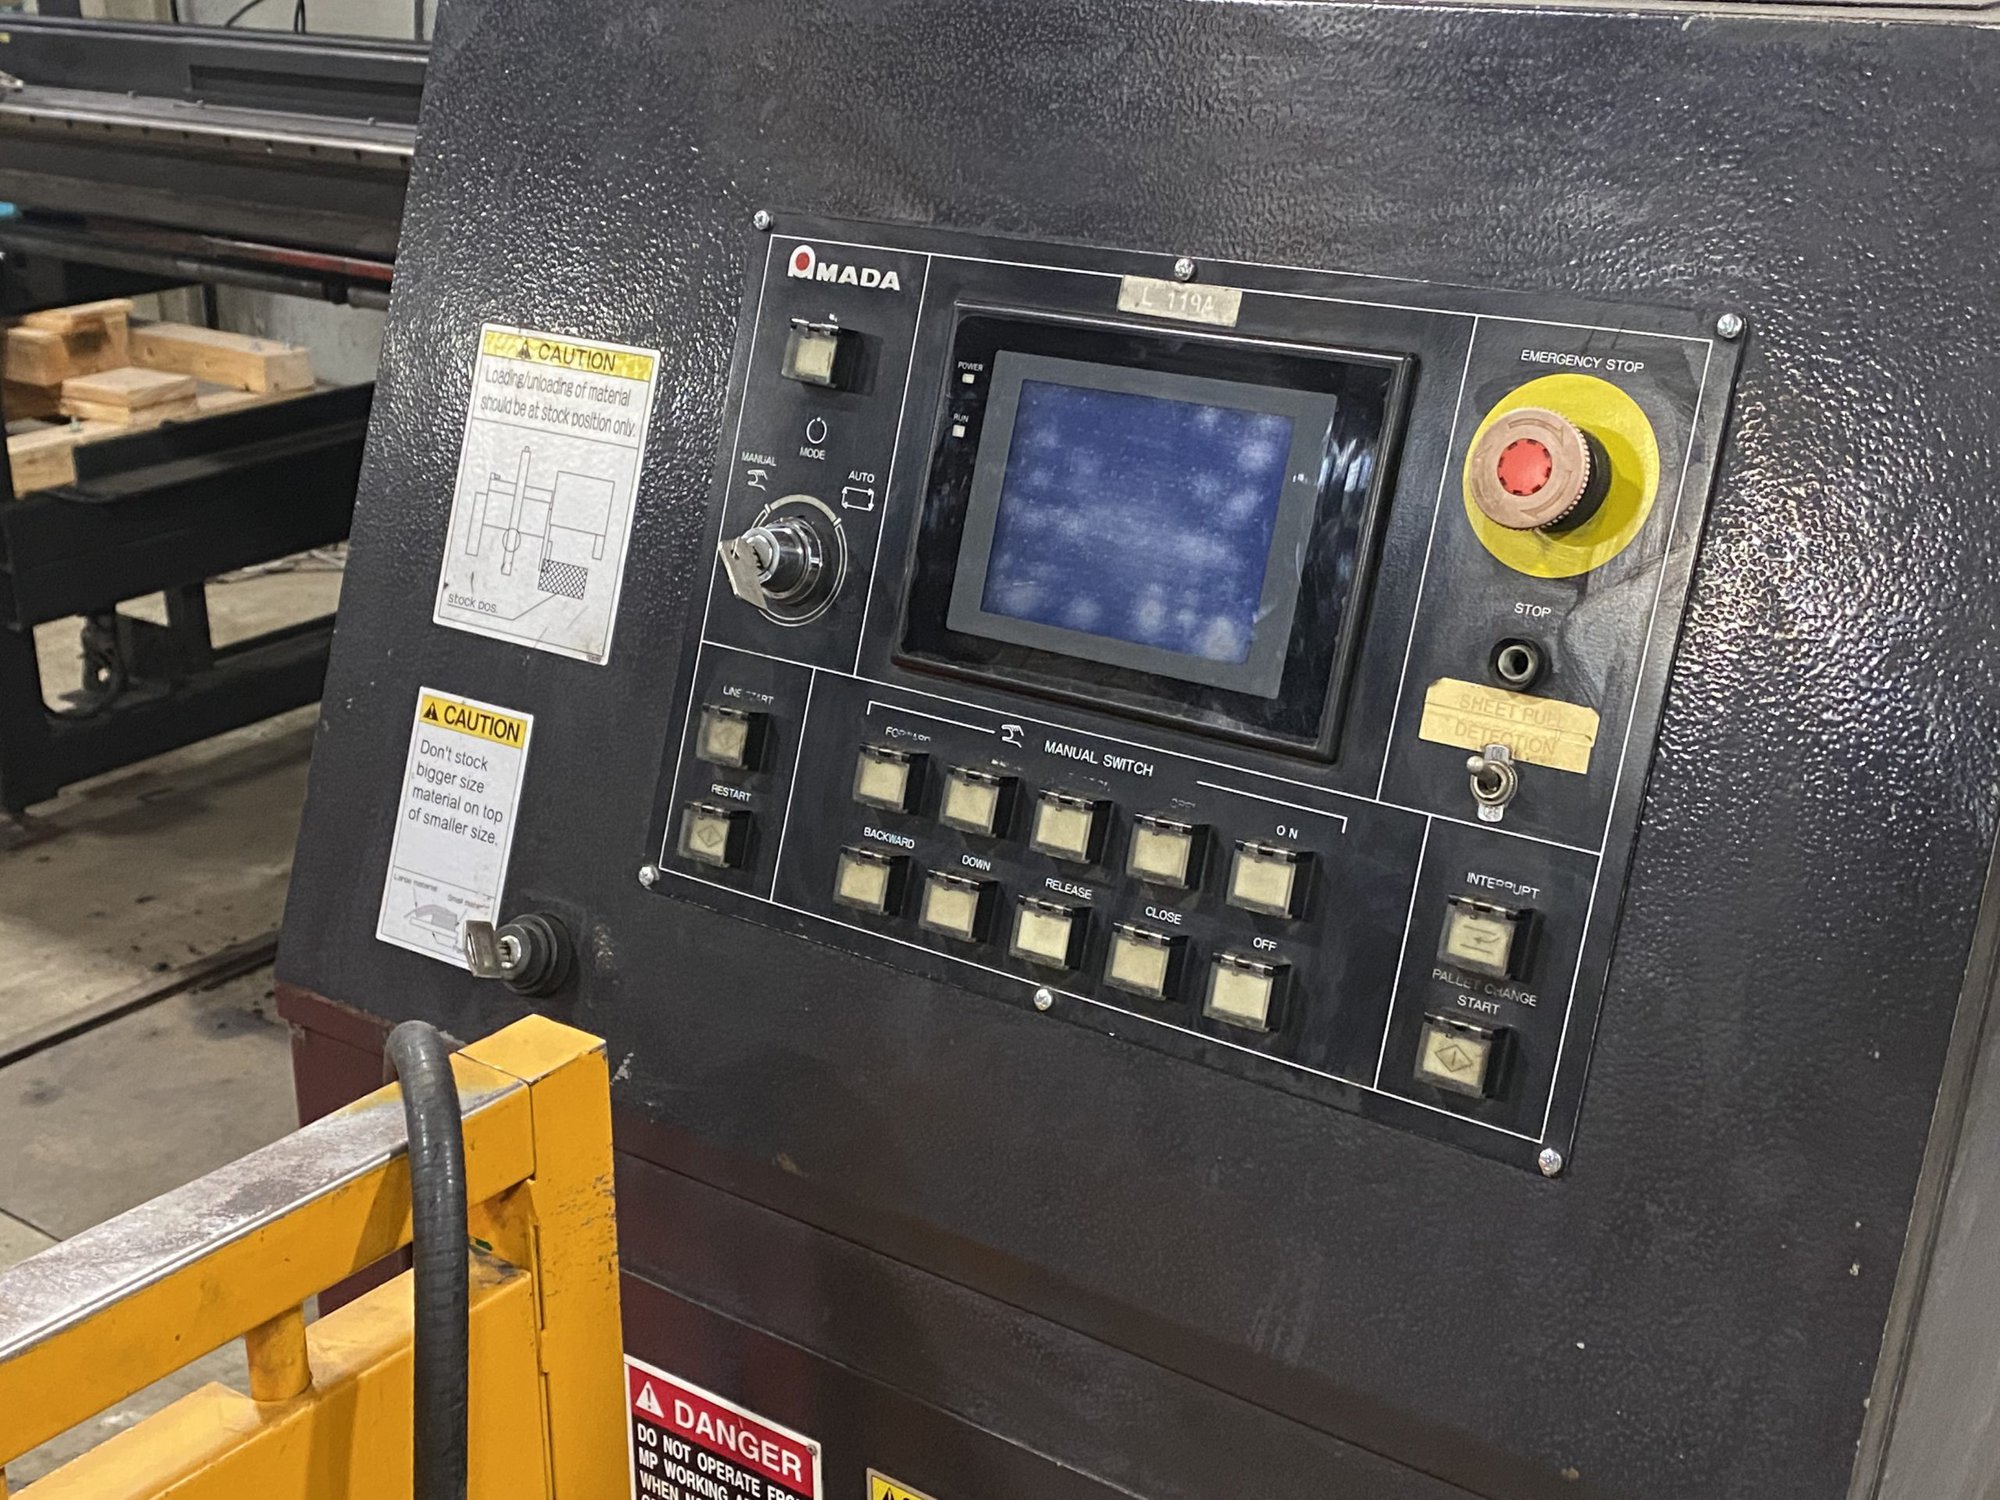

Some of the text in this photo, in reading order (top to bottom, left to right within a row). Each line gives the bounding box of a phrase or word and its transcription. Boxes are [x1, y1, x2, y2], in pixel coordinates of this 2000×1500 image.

[787, 245, 901, 291] AMADA
[538, 343, 616, 371] CAUTION
[958, 361, 984, 372] POWER
[1521, 349, 1645, 373] EMERGENCY STOP
[485, 367, 632, 407] Loading/unloading of material
[481, 395, 636, 438] should be at stock position only.
[953, 412, 969, 423] RUN
[741, 451, 777, 467] MANUAL
[800, 446, 826, 460] MODE
[848, 470, 875, 484] AUTO
[448, 593, 475, 608] stock
[1514, 602, 1551, 618] STOP
[1459, 694, 1520, 718] SHEET
[444, 705, 520, 743] CAUTION
[420, 739, 489, 771] Don't stock
[1044, 740, 1098, 765] MANUAL
[1102, 754, 1154, 777] SWITCH
[416, 762, 485, 793] bigger size
[711, 783, 752, 802] RESTART
[413, 786, 503, 825] material on top
[408, 807, 498, 846] of smaller size.
[864, 826, 915, 849] BACKWARD
[962, 855, 991, 871] DOWN
[1045, 877, 1093, 900] RELEASE
[1145, 906, 1182, 925] CLOSE
[1253, 937, 1277, 952] OFF
[1432, 968, 1480, 990] PALLET
[1457, 995, 1500, 1015] START
[674, 1399, 802, 1483] DANGER
[637, 1423, 657, 1447] DO
[663, 1435, 691, 1463] NOT
[697, 1452, 761, 1498] OPERATE
[639, 1447, 728, 1500] MP WORKING
[639, 1469, 679, 1500] WHEN
